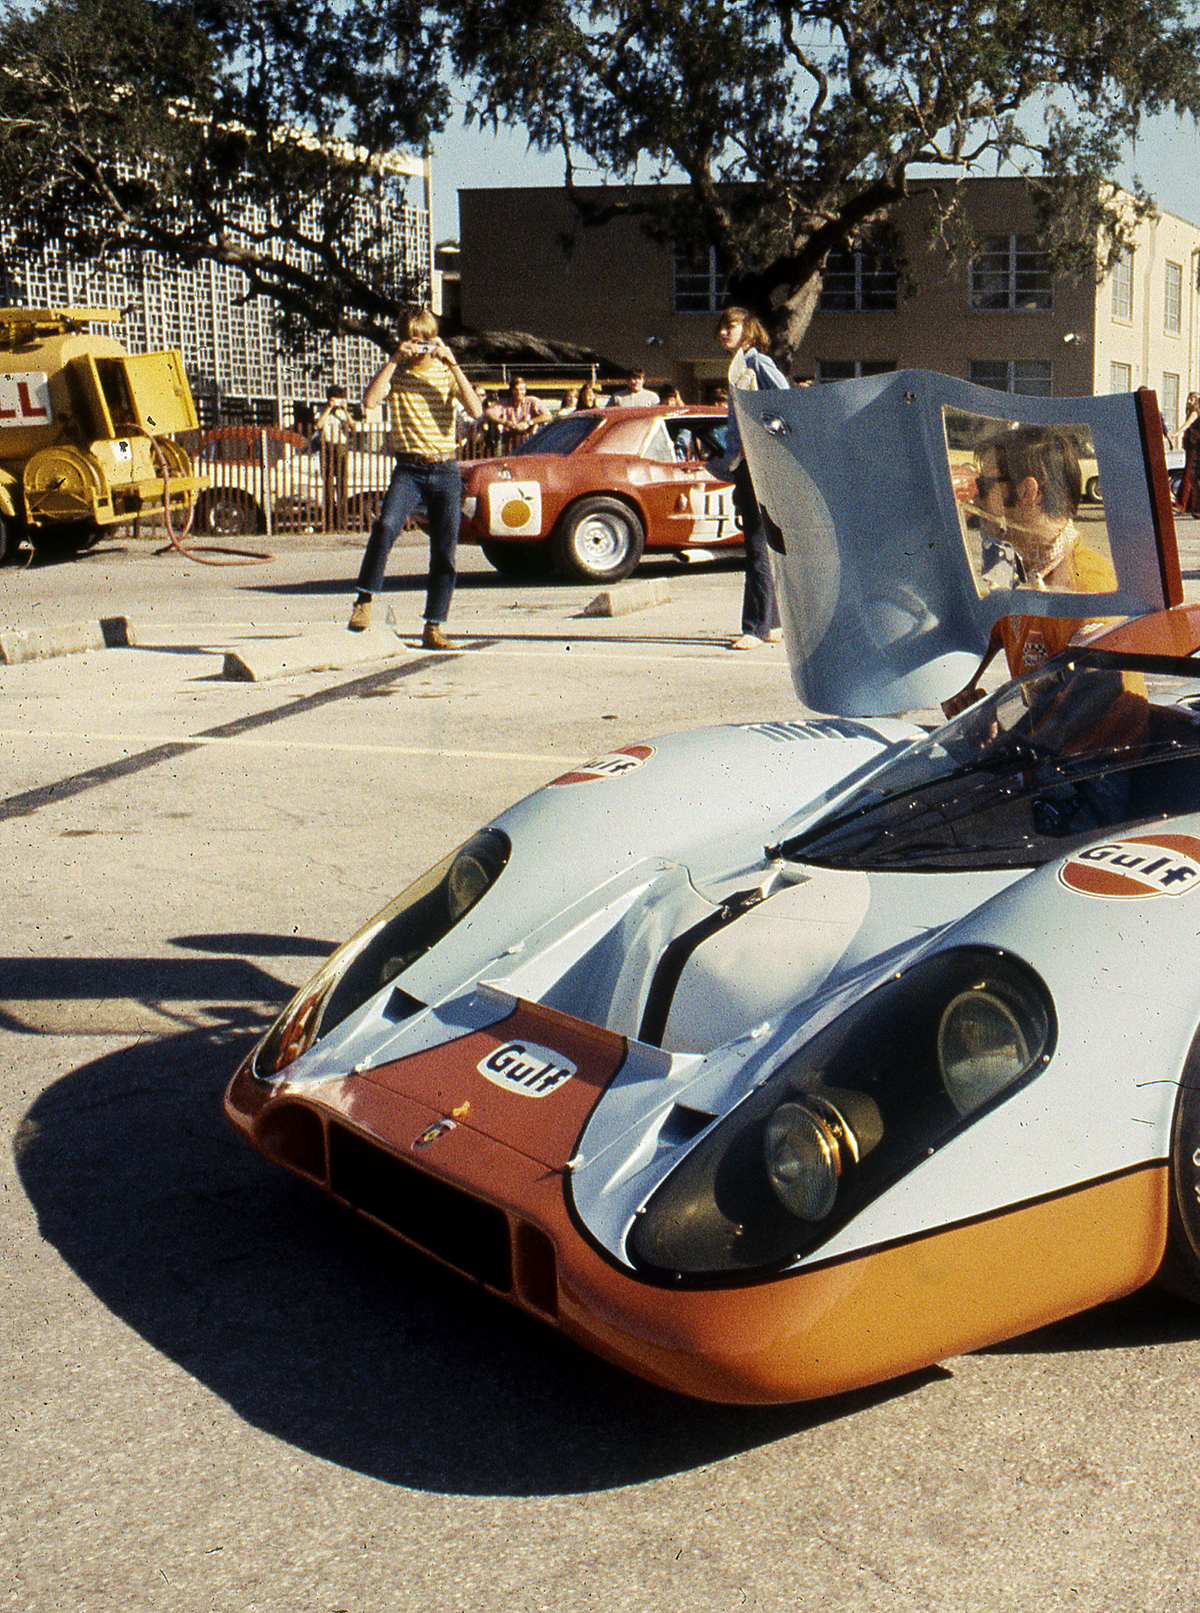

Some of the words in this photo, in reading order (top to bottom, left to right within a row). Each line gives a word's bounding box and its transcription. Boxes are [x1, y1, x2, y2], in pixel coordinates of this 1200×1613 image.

[582, 758, 637, 773] ulf
[1078, 844, 1198, 887] Gulf
[486, 1044, 571, 1093] Gulf
